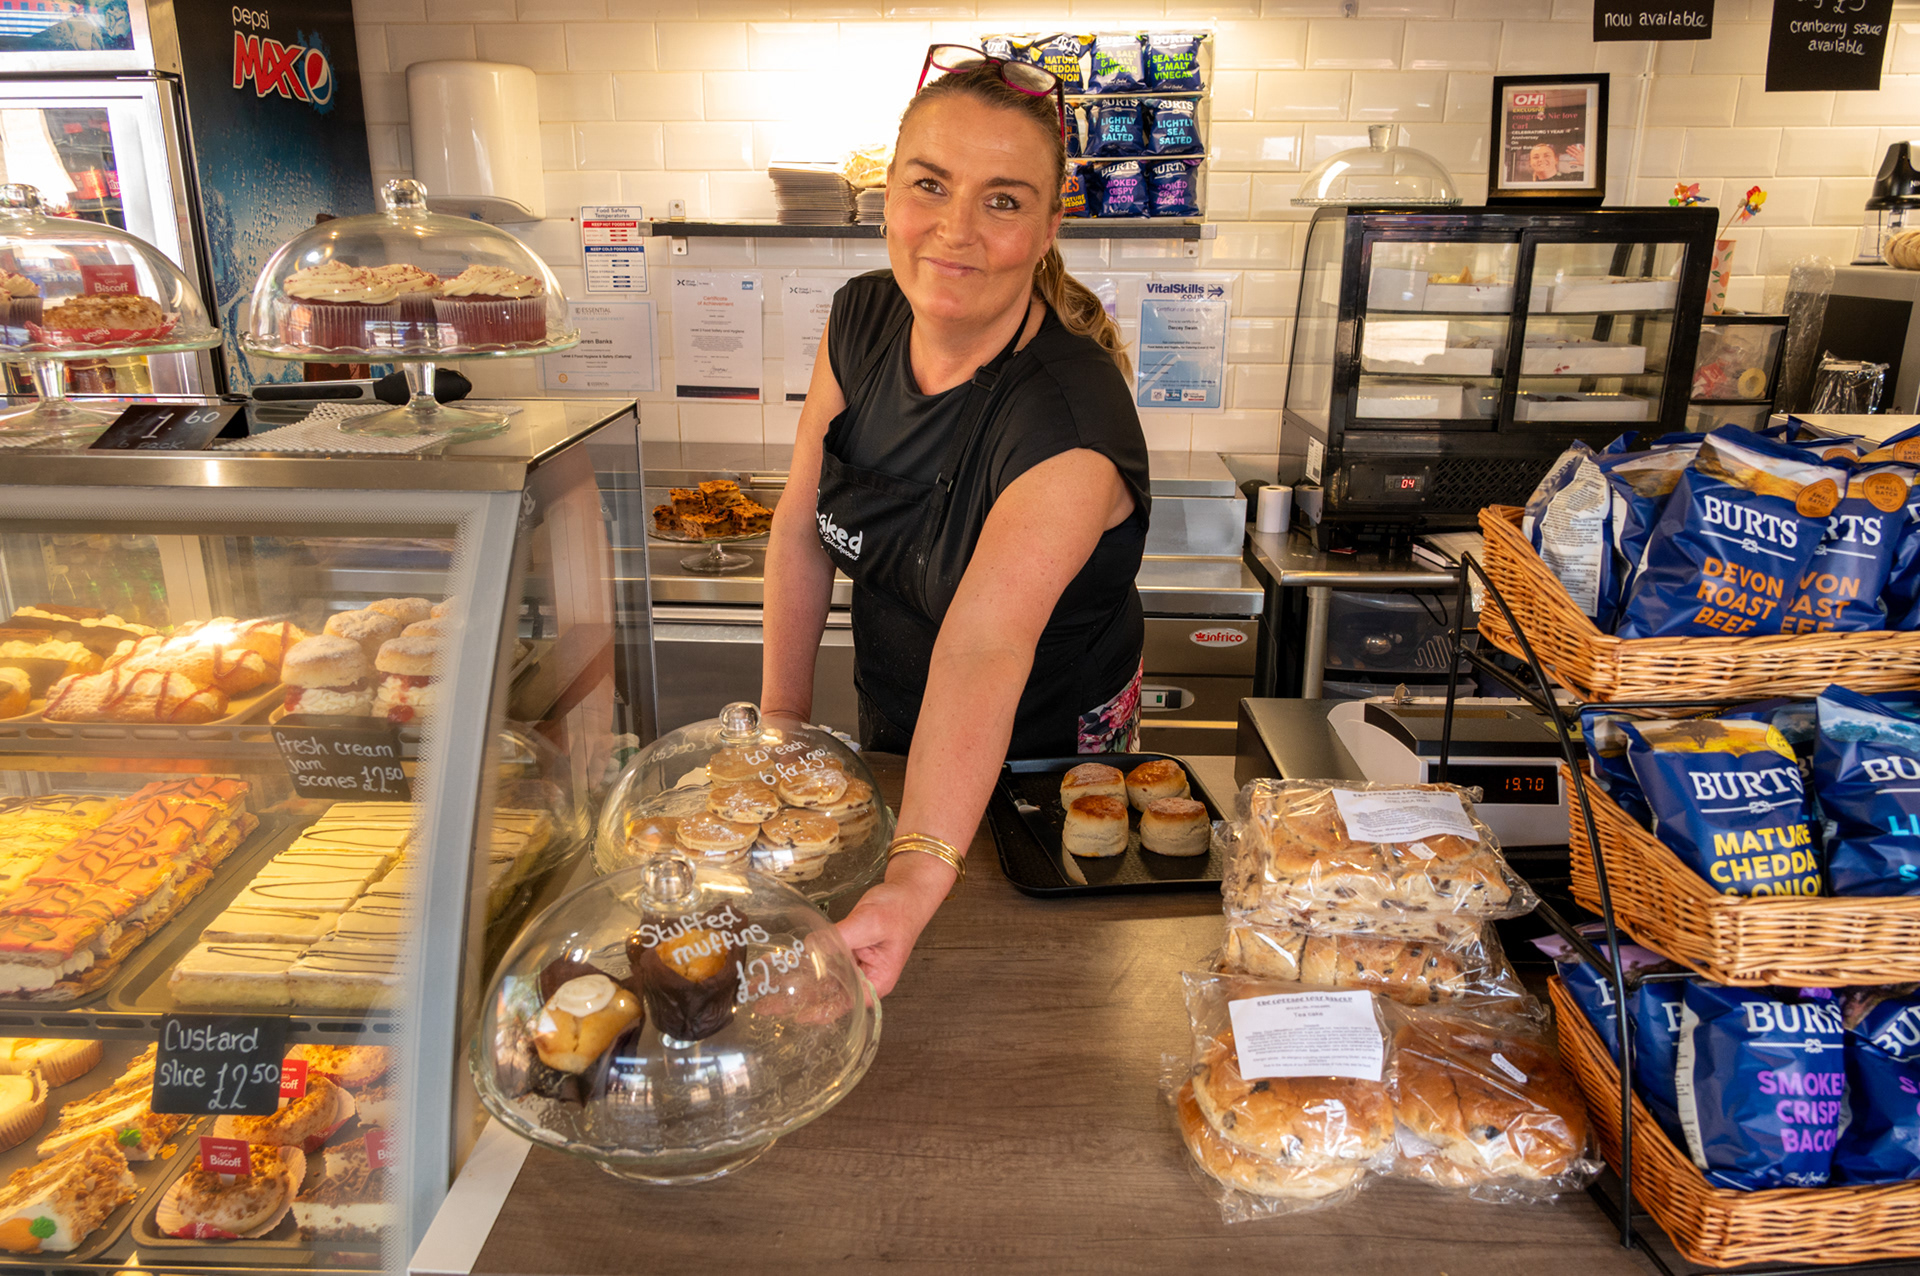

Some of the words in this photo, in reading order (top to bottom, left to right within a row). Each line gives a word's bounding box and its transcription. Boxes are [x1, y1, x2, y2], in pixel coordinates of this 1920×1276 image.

[232, 5, 270, 31] pepsi
[1604, 12, 1632, 28] now
[1639, 10, 1708, 28] available
[1790, 19, 1847, 39] cranberry
[1853, 23, 1882, 36] sauce
[1052, 36, 1080, 54] RTS
[1808, 39, 1865, 55] available
[1044, 55, 1078, 64] MATURE
[1096, 51, 1113, 60] SEA
[1117, 50, 1137, 58] SALT
[1101, 59, 1108, 67] &
[1109, 58, 1133, 66] MALT
[1152, 54, 1170, 63] SEA
[1173, 53, 1194, 61] SALT
[233, 30, 310, 103] MAX
[1043, 65, 1080, 73] CHEDDAR
[1098, 65, 1138, 76] VINEGAR
[1157, 63, 1165, 71] &
[1165, 62, 1190, 71] MALT
[1056, 73, 1080, 82] NION
[1154, 71, 1193, 80] VINEGAR
[1102, 98, 1140, 107] BURTS
[1158, 100, 1194, 110] BURTS
[1514, 94, 1544, 105] OH!
[1101, 117, 1136, 126] LIGHTLY
[1109, 125, 1127, 133] SEA
[1157, 119, 1193, 128] LIGHTLY
[1102, 133, 1134, 141] SALTED
[1167, 128, 1185, 136] SEA
[1159, 136, 1193, 145] SALTED
[1109, 187, 1134, 195] CRISPY
[1108, 195, 1134, 204] BACON
[1156, 198, 1185, 206] BACON
[94, 282, 129, 293] Biscoff
[1146, 283, 1205, 293] VitalSkills
[1400, 478, 1416, 489] 04
[1808, 497, 1830, 508] BATCH
[1812, 492, 1832, 503] SMALL
[816, 497, 863, 554] aked
[1703, 494, 1799, 548] BURTS
[1823, 513, 1883, 546] RTS
[1702, 556, 1784, 599] DEVON
[1800, 571, 1861, 598] VON
[1696, 580, 1778, 620] ROAST
[1789, 594, 1851, 619] AST
[1693, 606, 1757, 634] BEEF
[1780, 616, 1835, 635] EEF
[1206, 632, 1243, 642] infrico
[276, 731, 329, 755] fresh
[334, 741, 394, 758] cream
[775, 740, 809, 755] each
[286, 755, 326, 774] jam
[759, 771, 776, 785] 6
[775, 762, 799, 783] for
[298, 774, 357, 789] scones
[1505, 777, 1544, 791] 19.70
[1689, 767, 1804, 800] BURTS
[1713, 823, 1812, 856] MATURE
[1710, 849, 1818, 883] CHEDDA
[1752, 876, 1822, 897] ONIO
[639, 904, 742, 948] Stuffed
[671, 924, 770, 965] muffins
[1741, 1001, 1844, 1034] BURTS
[165, 1019, 259, 1053] Custard
[159, 1059, 206, 1087] Slice
[281, 1079, 299, 1090] coff
[1757, 1071, 1845, 1096] SMOKE
[1776, 1100, 1842, 1125] CRISP
[210, 1155, 242, 1168] Biscoff
